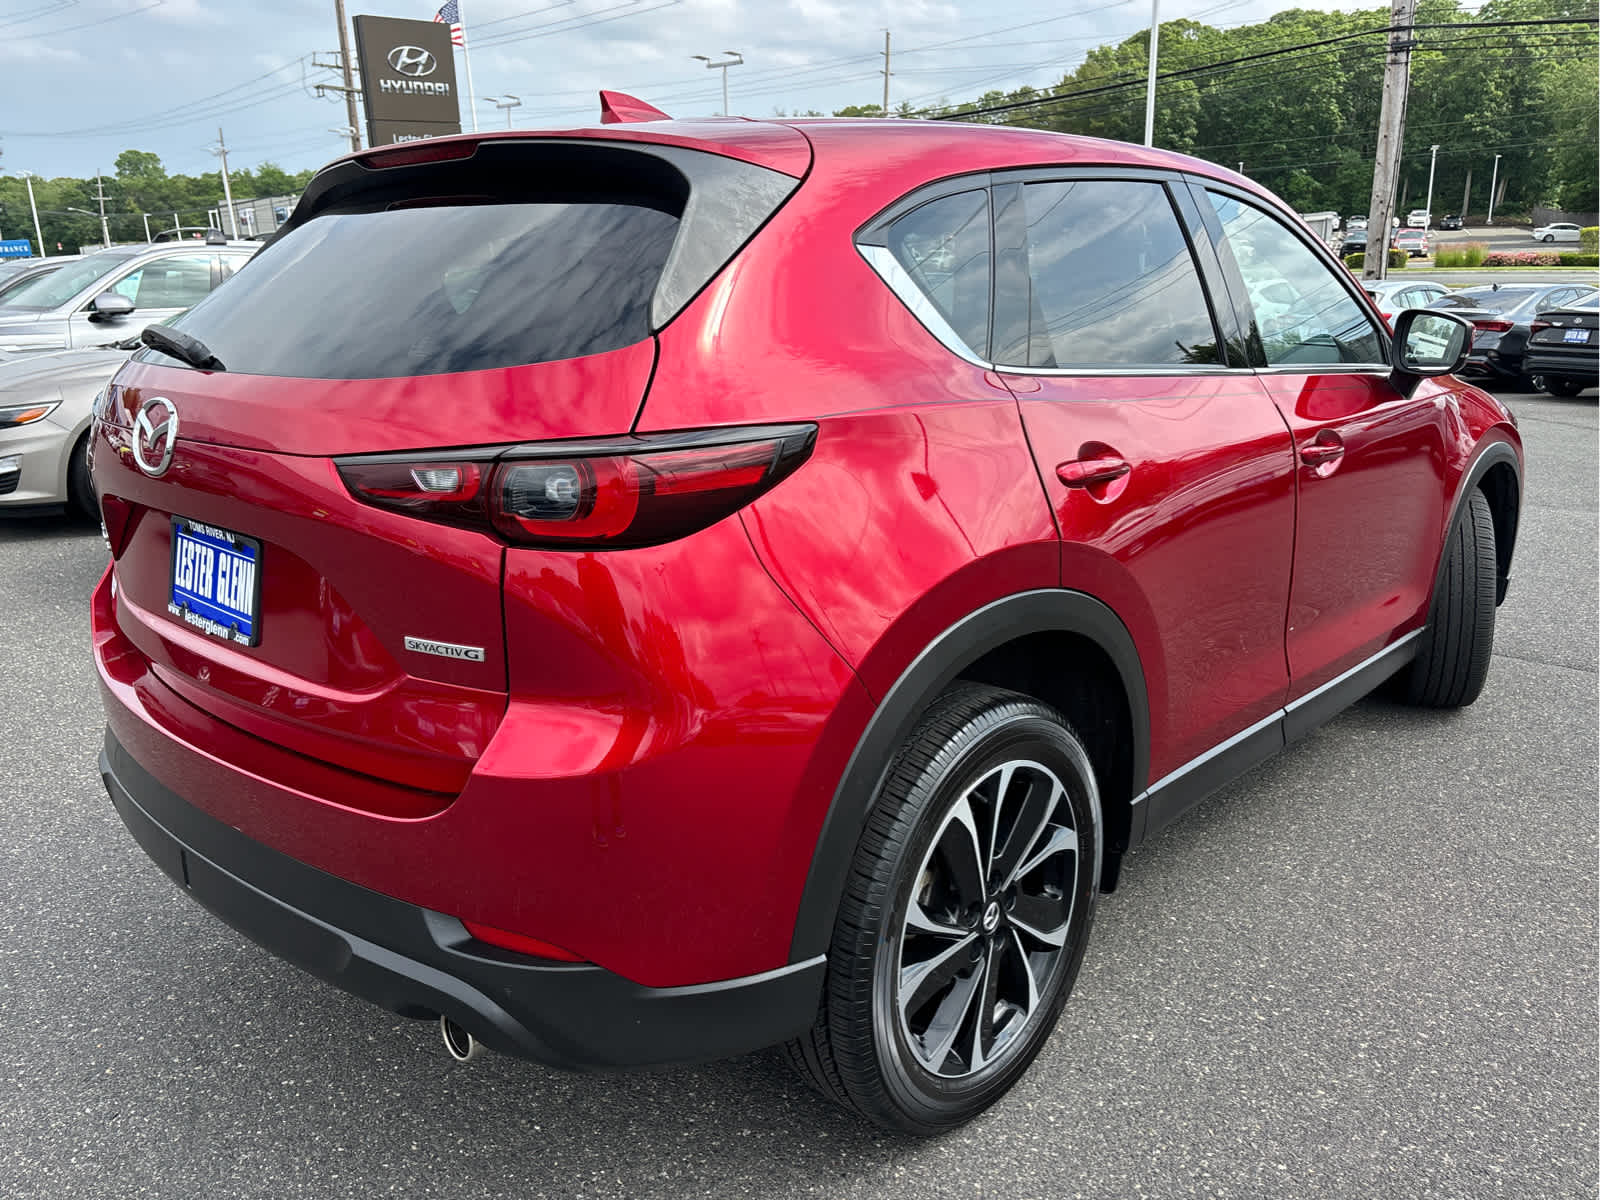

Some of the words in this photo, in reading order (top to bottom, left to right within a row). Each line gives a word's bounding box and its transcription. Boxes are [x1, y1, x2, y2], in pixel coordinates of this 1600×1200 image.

[379, 79, 450, 96] HYUNDAI
[188, 520, 205, 534] TOMS
[226, 532, 235, 544] NJ
[175, 537, 215, 599] LESTER
[216, 552, 256, 616] GLENN
[184, 609, 229, 640] lesterglenn
